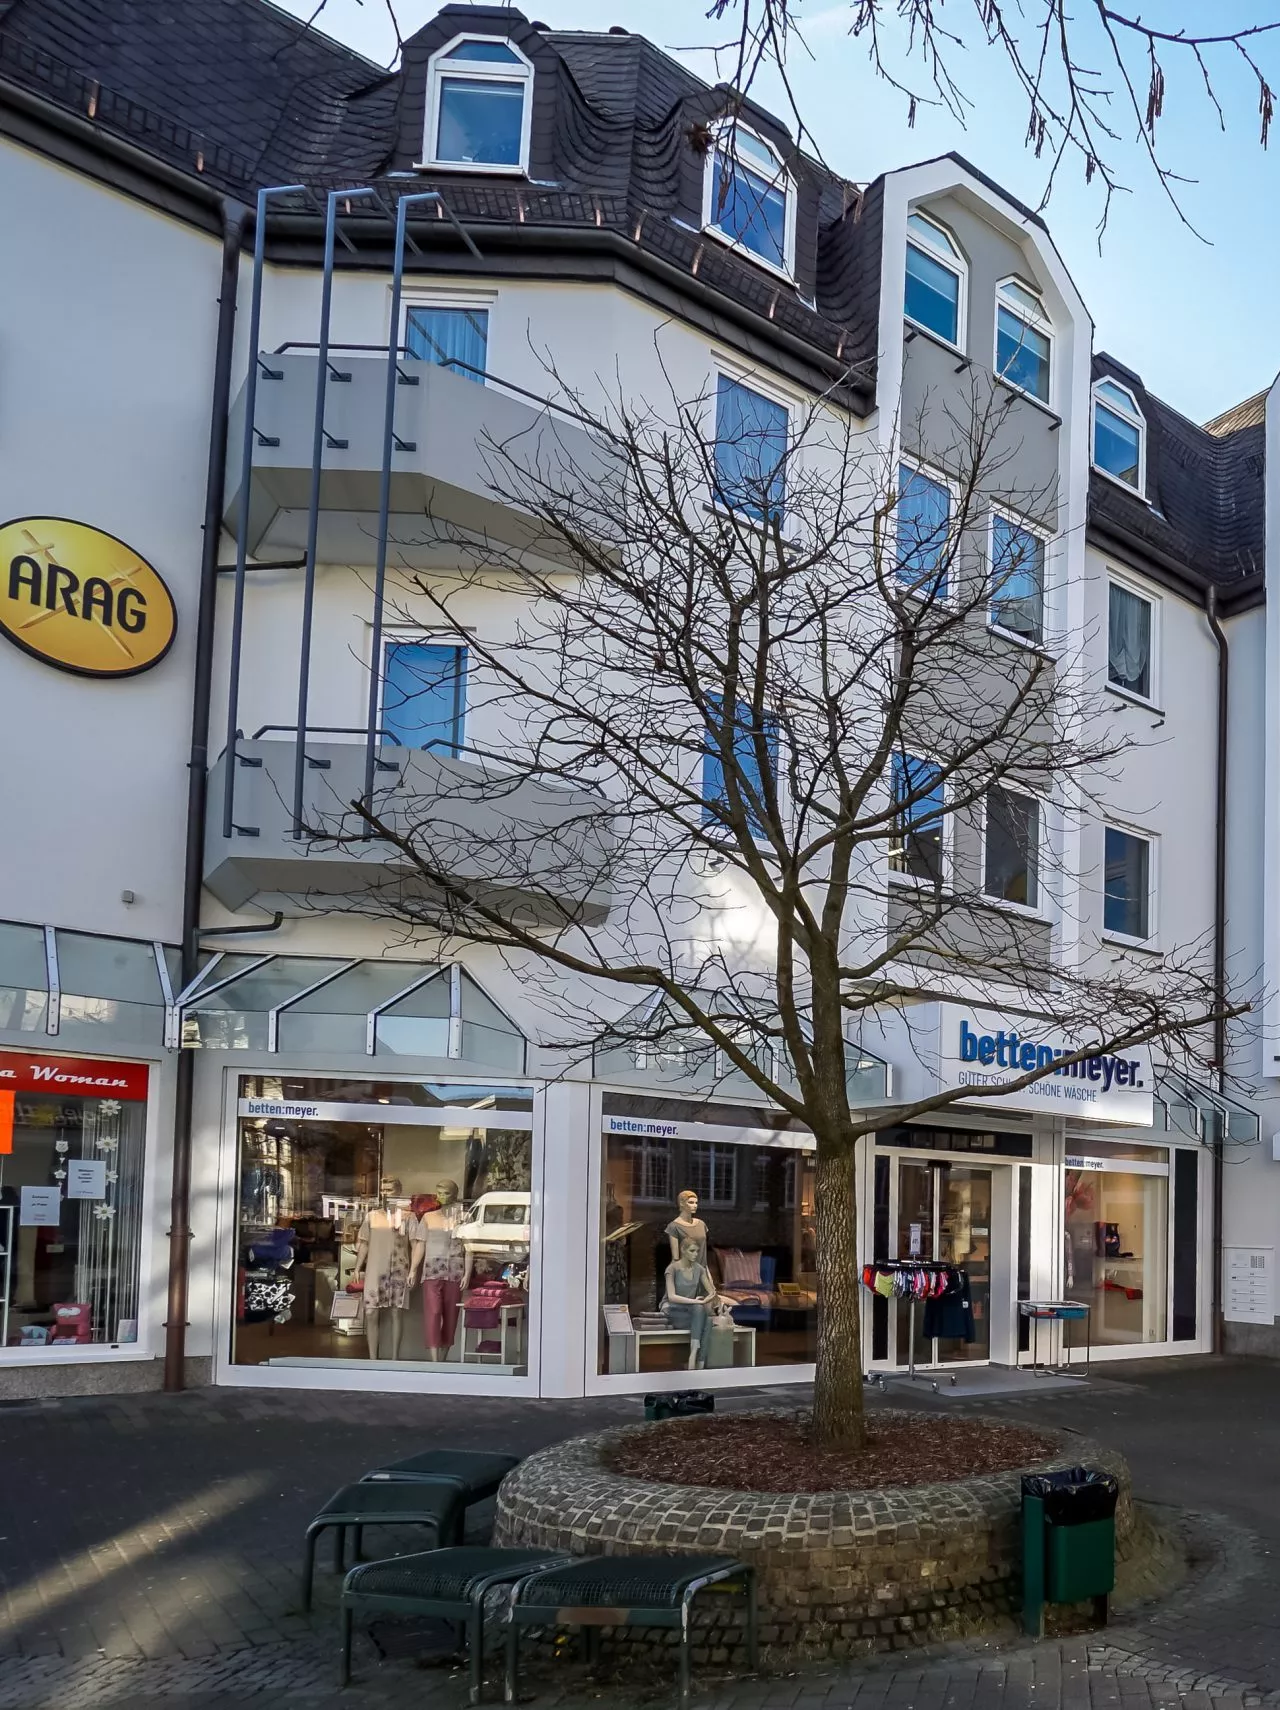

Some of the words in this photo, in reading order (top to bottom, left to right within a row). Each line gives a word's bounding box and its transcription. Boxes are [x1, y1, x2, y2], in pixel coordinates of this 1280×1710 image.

[8, 555, 147, 634] ARAG
[30, 1065, 128, 1088] Woman
[958, 1071, 988, 1087] GUTER
[1028, 1080, 1061, 1098] SCHÖNE
[248, 1101, 319, 1118] betten:meyer.
[610, 1118, 679, 1136] betten:meyer.
[1064, 1156, 1105, 1170] bettenmeyer.
